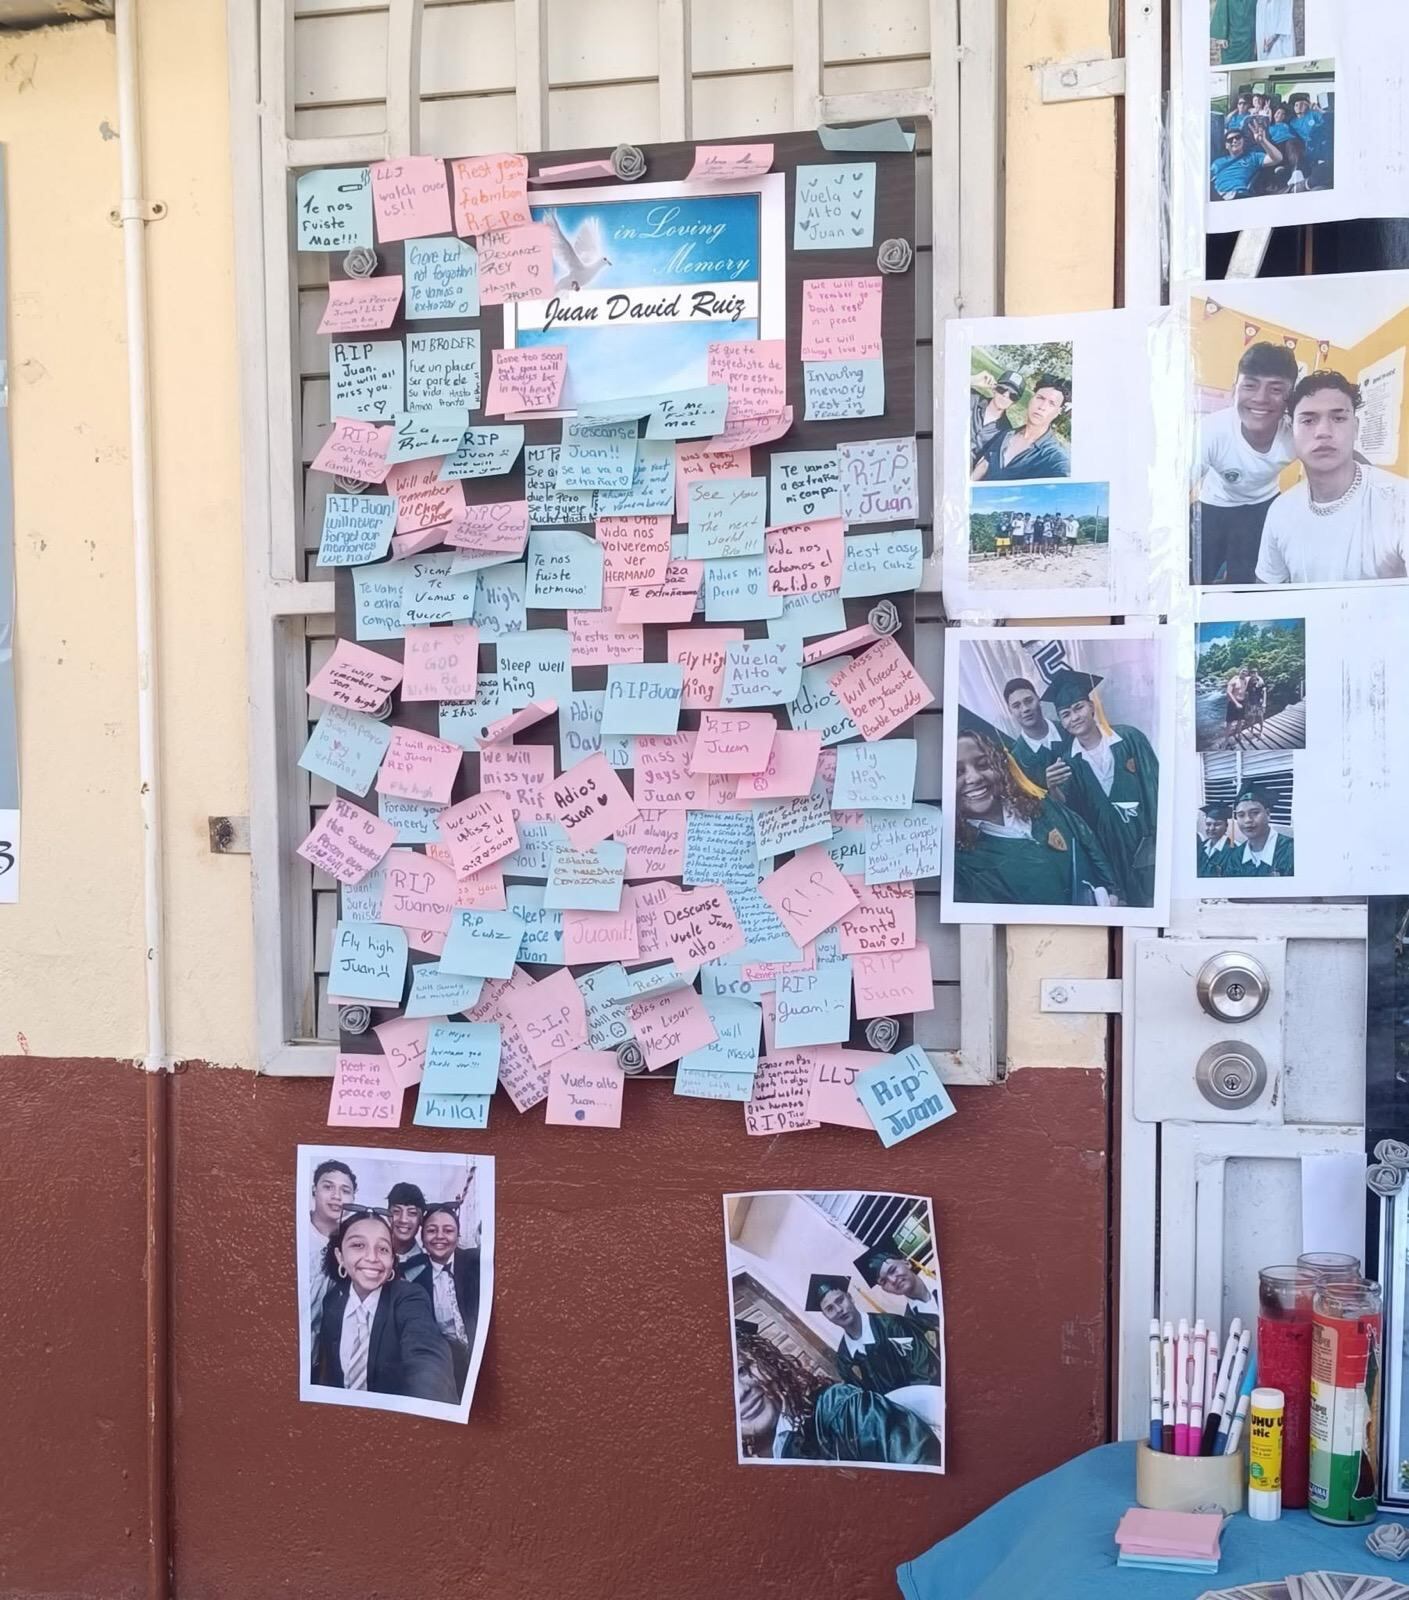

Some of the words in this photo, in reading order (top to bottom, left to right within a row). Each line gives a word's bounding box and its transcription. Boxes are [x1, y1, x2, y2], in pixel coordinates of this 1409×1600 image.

[377, 167, 403, 180] LLJ
[379, 184, 416, 201] watch
[422, 182, 445, 194] over
[800, 186, 841, 204] Vuela
[327, 202, 353, 213] nos
[613, 224, 638, 241] in
[639, 205, 727, 245] Loving
[808, 224, 845, 241] Juan
[410, 246, 439, 265] Gone
[443, 245, 461, 263] but
[652, 242, 752, 280] Memory
[414, 267, 428, 281] not
[411, 285, 424, 301] Te
[542, 296, 599, 333] Juan
[606, 294, 680, 321] David
[691, 290, 747, 323] Ruiz
[837, 335, 855, 344] will
[334, 344, 373, 364] RIP
[445, 360, 475, 376] placer
[540, 362, 559, 371] will
[768, 358, 783, 370] de
[356, 373, 377, 385] will
[427, 374, 449, 391] parte
[453, 374, 467, 385] de
[728, 371, 748, 384] pero
[336, 388, 363, 400] miss
[422, 386, 442, 397] vida
[809, 384, 866, 399] memory
[659, 400, 674, 413] Te
[811, 398, 839, 409] rest
[846, 396, 863, 409] in
[341, 426, 379, 443] RIP
[463, 431, 500, 446] RIP
[568, 423, 636, 440] Descanse
[456, 448, 494, 459] Juan
[681, 452, 700, 461] was
[325, 460, 362, 478] family
[597, 466, 612, 475] va
[780, 465, 799, 479] Te
[804, 460, 837, 473] vamos
[396, 474, 418, 493] Will
[565, 475, 618, 487] extrañar
[780, 483, 788, 492] a
[399, 485, 455, 503] remember
[692, 485, 724, 502] See
[730, 490, 759, 506] you
[328, 496, 359, 513] RIP
[859, 491, 913, 515] Juan
[708, 510, 723, 518] in
[729, 515, 758, 531] next
[361, 532, 381, 542] our
[633, 528, 654, 539] nos
[707, 530, 745, 546] world
[800, 543, 821, 553] nos
[847, 542, 880, 559] Rest
[887, 543, 920, 561] easy
[534, 553, 546, 566] Te
[550, 556, 571, 565] nos
[603, 559, 613, 567] a
[624, 556, 646, 567] ver
[535, 568, 571, 583] fuiste
[605, 568, 656, 582] HERMANO
[359, 582, 372, 594] Te
[486, 587, 521, 611] High
[678, 651, 699, 671] Fly
[729, 652, 778, 666] Vuela
[732, 667, 769, 681] Alto
[866, 658, 901, 687] forever
[609, 680, 649, 700] RIP
[730, 683, 772, 697] Juan
[706, 719, 751, 734] RIP
[703, 739, 750, 754] Juan
[403, 752, 434, 764] Juan
[641, 751, 675, 765] miss
[855, 746, 878, 769] Fly
[483, 770, 518, 785] miss
[851, 769, 887, 790] High
[554, 777, 598, 810] Adios
[643, 789, 681, 802] Juan
[466, 801, 493, 821] will
[560, 804, 595, 829] Juan
[523, 825, 548, 838] will
[643, 825, 680, 841] always
[626, 844, 680, 857] remember
[390, 868, 437, 896] RIP
[393, 894, 434, 913] Juan
[663, 897, 721, 926] Descanse
[462, 912, 484, 927] Rip
[512, 905, 547, 925] Sleep
[708, 913, 733, 931] Juan
[341, 930, 360, 950] Fly
[368, 936, 395, 959] high
[688, 939, 716, 959] alto
[340, 958, 375, 975] Juan
[859, 952, 903, 975] RIP
[633, 975, 665, 993] Rest
[714, 976, 751, 997] bro
[781, 975, 818, 994] RIP
[862, 985, 914, 1001] Juan
[720, 1022, 742, 1038] will
[340, 1059, 365, 1073] Rest
[369, 1063, 380, 1072] in
[596, 1075, 619, 1090] alto
[819, 1063, 860, 1086] LLJ
[338, 1087, 376, 1100] peace
[870, 1074, 922, 1108] Rip
[882, 1093, 945, 1137] Juan
[1251, 1413, 1274, 1429] UHU
[1252, 1427, 1271, 1438] stic
